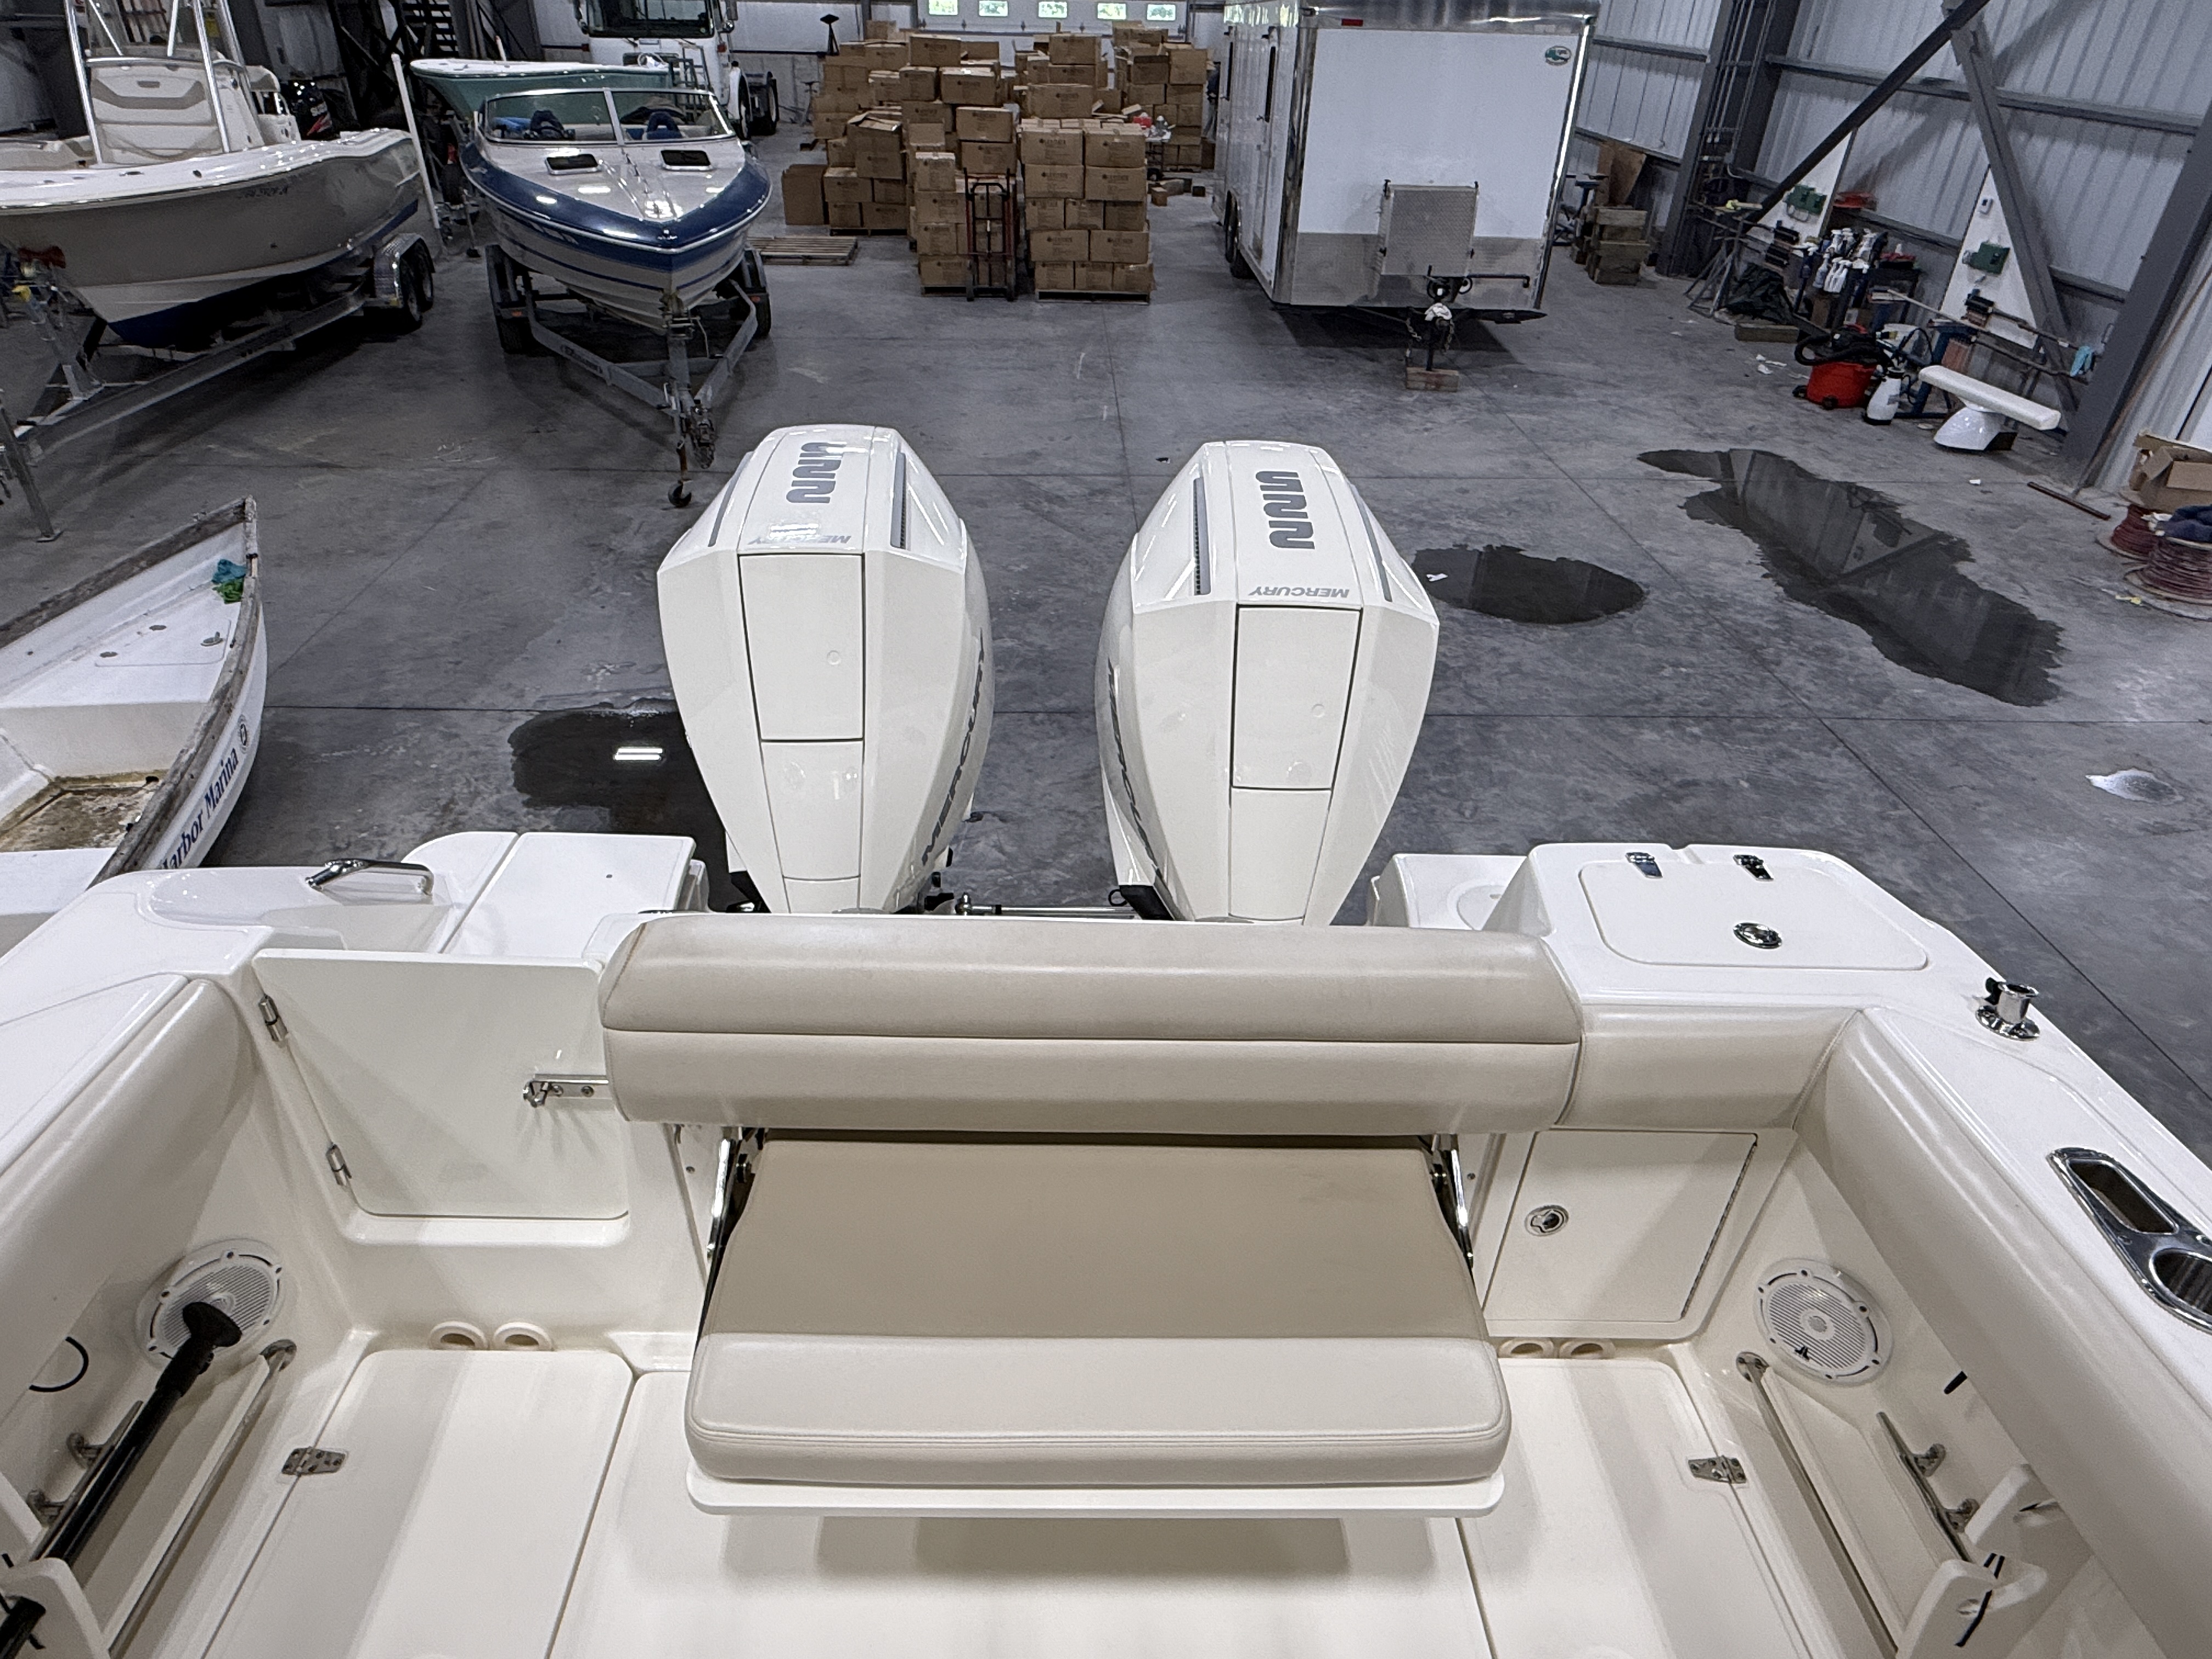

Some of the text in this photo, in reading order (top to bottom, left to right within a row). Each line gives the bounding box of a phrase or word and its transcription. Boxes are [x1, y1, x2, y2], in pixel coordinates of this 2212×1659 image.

[1255, 471, 1316, 550] 225
[1248, 586, 1350, 598] MERCURY
[204, 747, 239, 820] Marina
